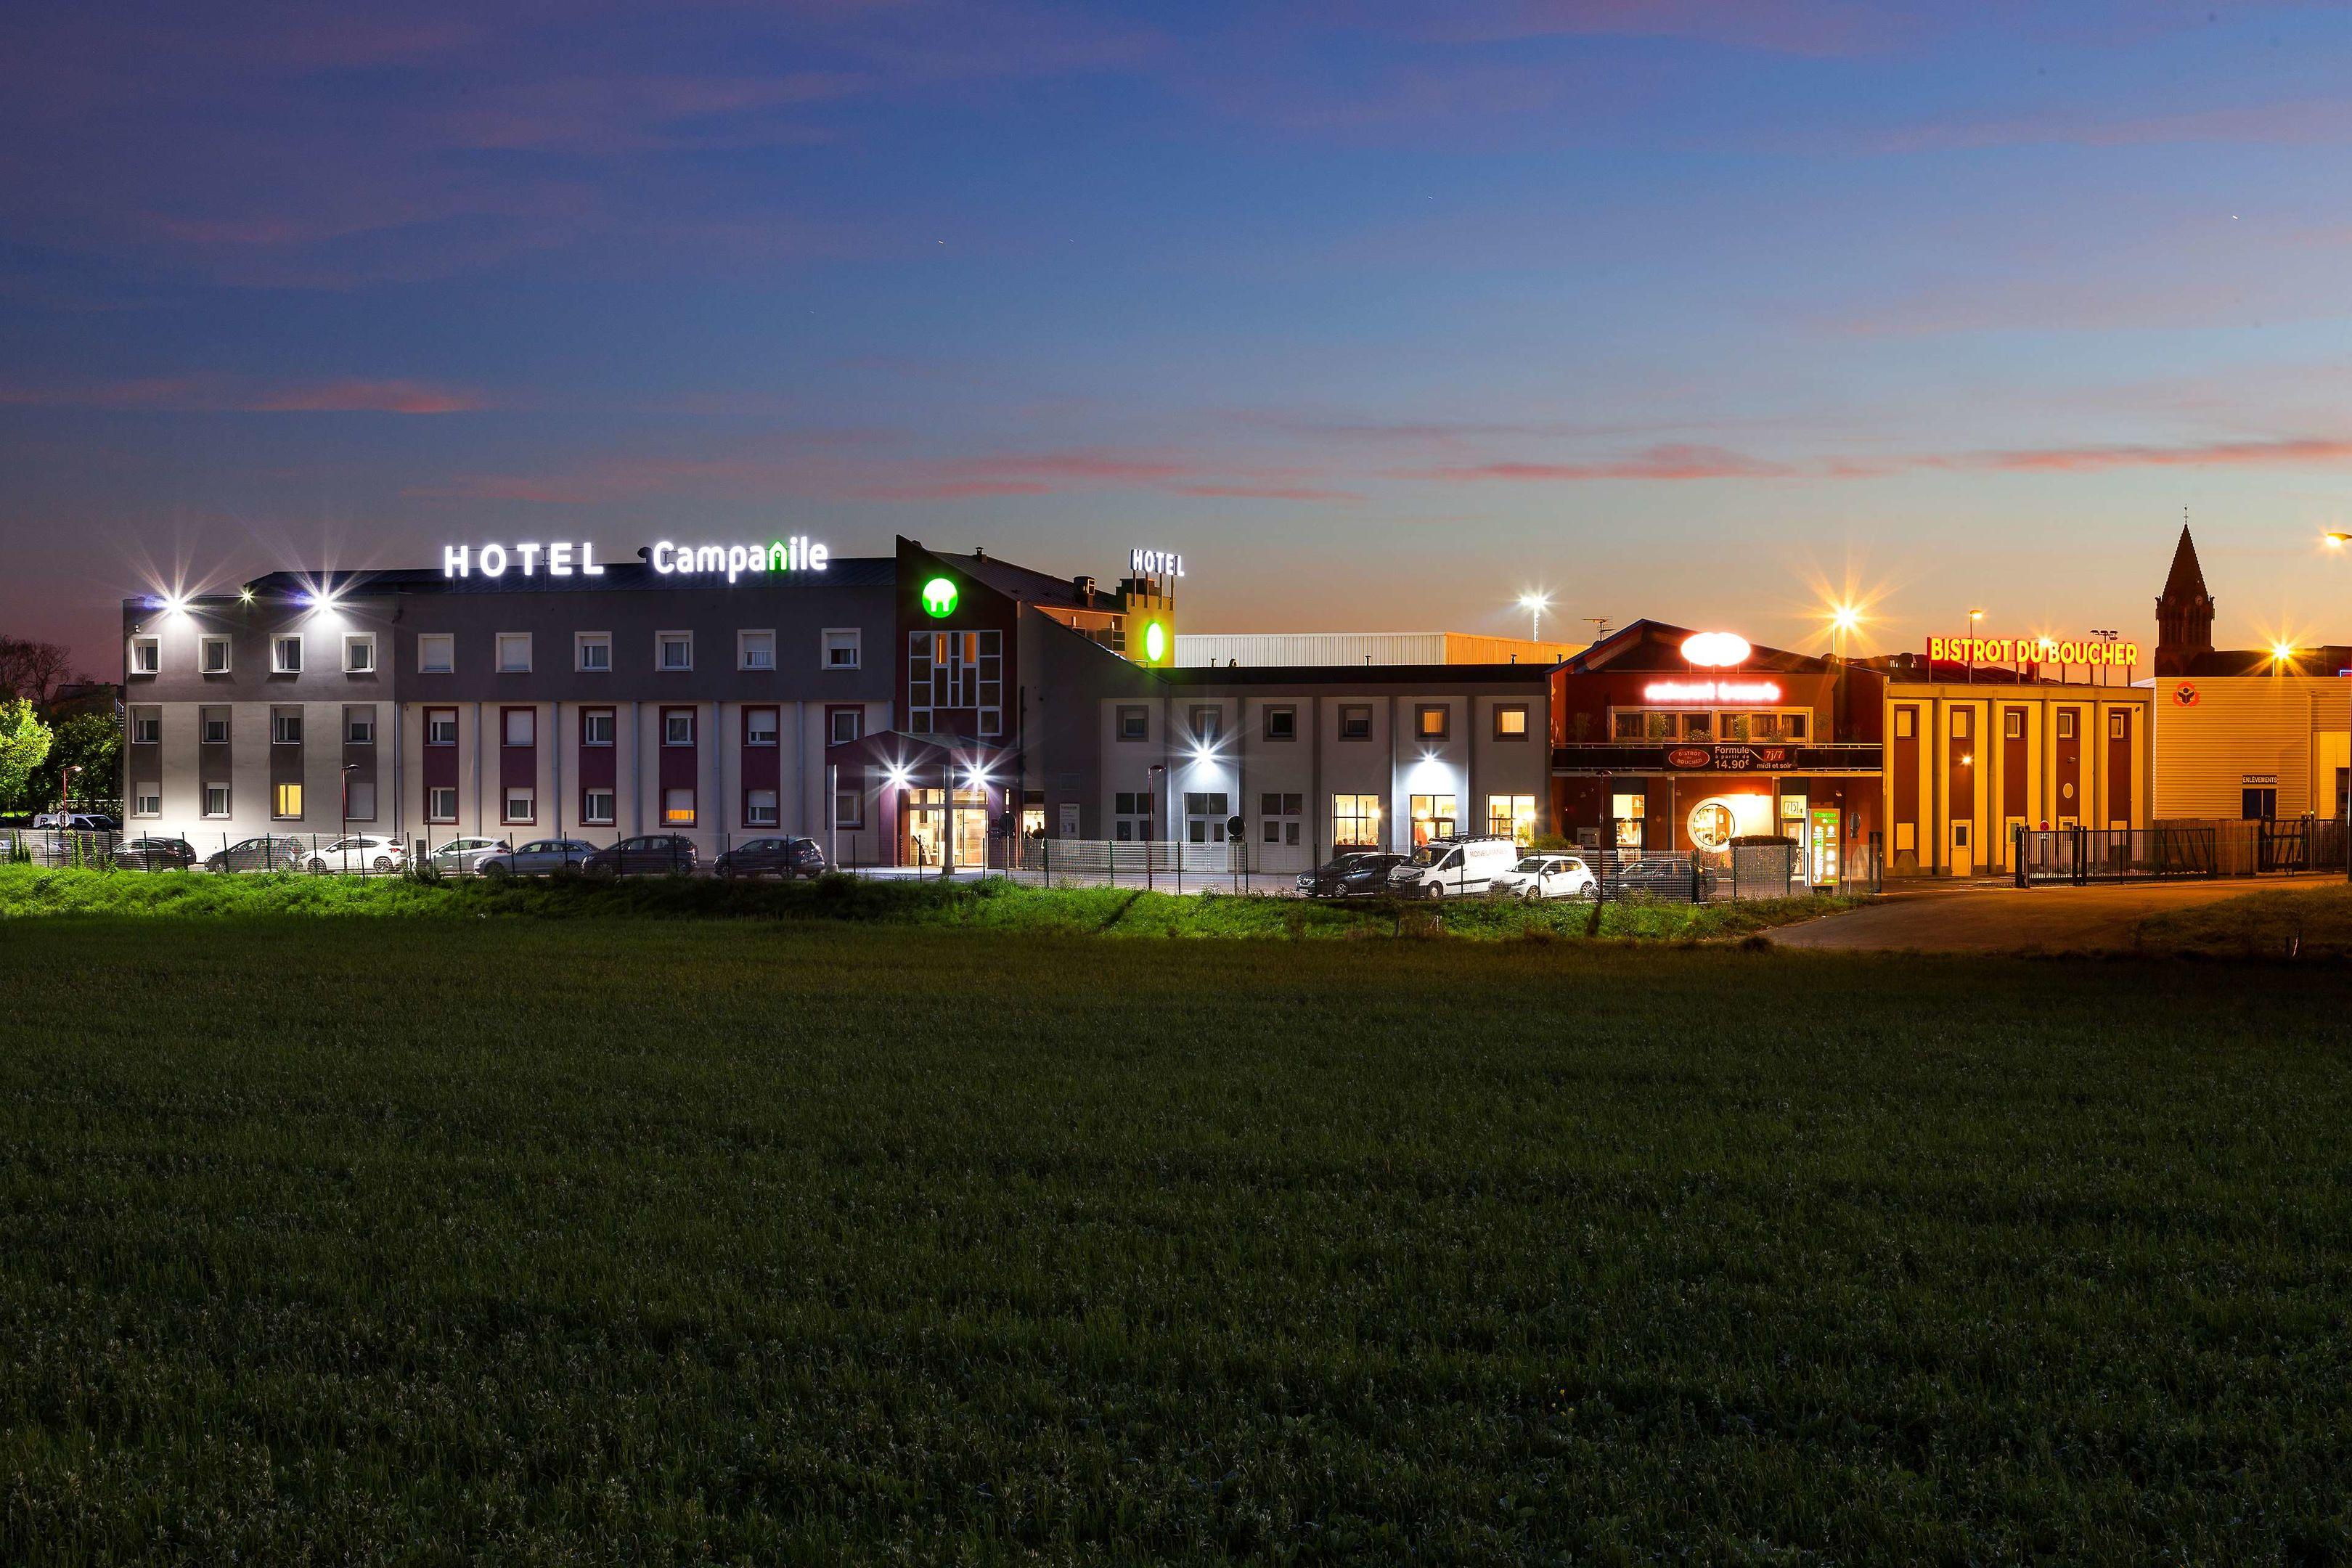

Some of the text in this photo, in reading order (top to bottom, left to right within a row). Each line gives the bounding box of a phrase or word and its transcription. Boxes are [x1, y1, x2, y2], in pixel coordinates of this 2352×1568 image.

[444, 536, 828, 583] HOTEL Campanile
[1132, 548, 1185, 576] HOTEL
[1930, 637, 2138, 666] BISTROT DU BOUCHER
[1715, 759, 1749, 769] 14.90€
[1765, 751, 1783, 760] 7j/7
